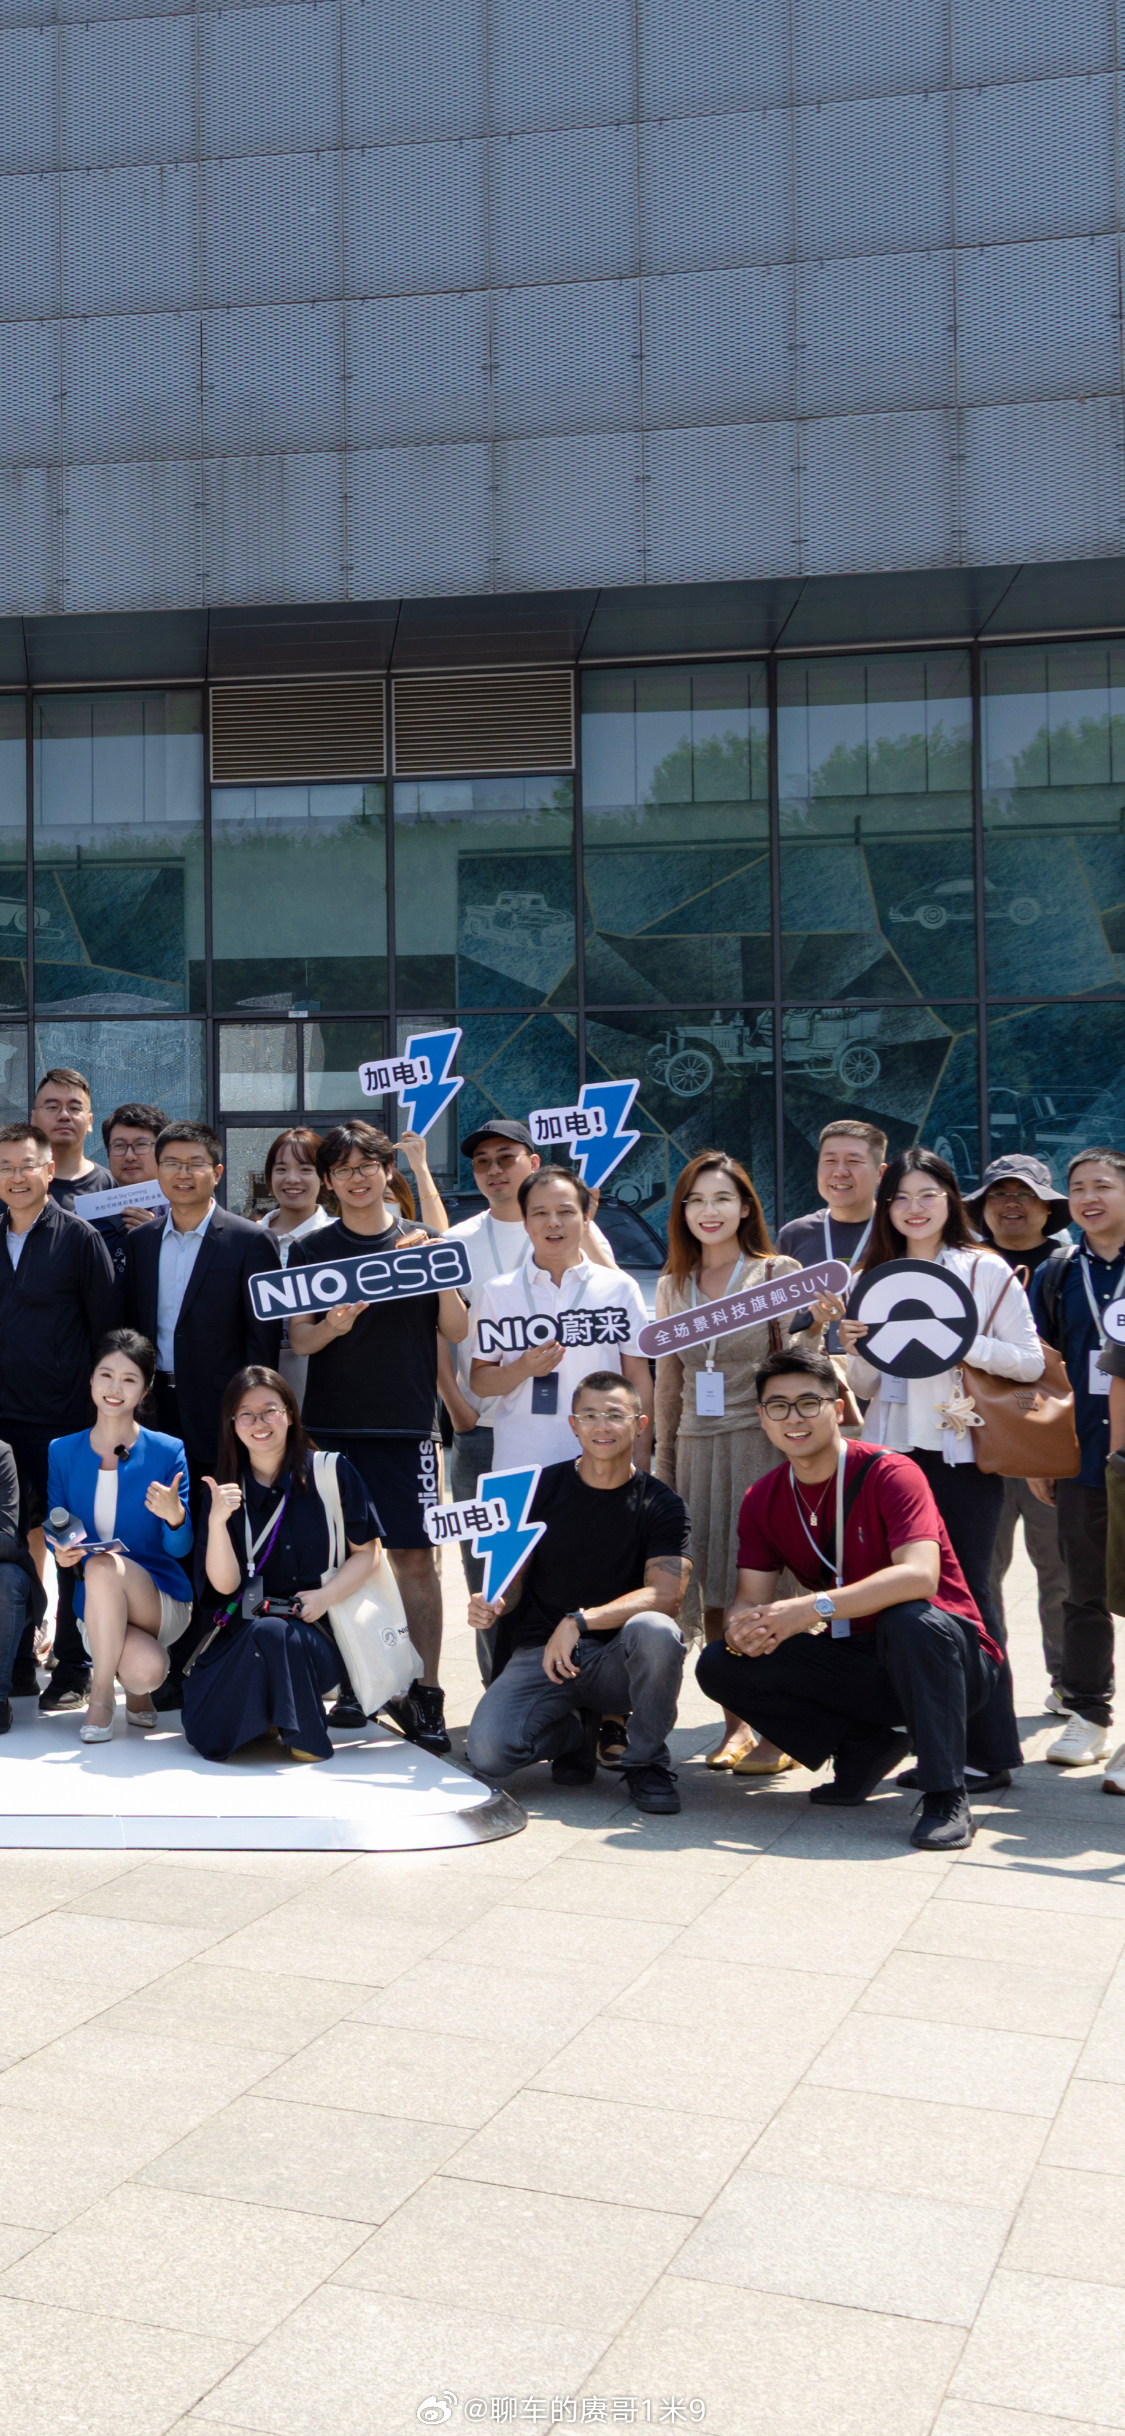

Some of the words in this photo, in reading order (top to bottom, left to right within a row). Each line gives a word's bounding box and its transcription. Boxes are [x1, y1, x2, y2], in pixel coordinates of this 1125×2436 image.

[364, 1060, 428, 1091] 加电!
[535, 1111, 602, 1140] 加电!
[256, 1268, 348, 1313] NIO
[654, 1272, 829, 1347] 全场景科技旗舰SUV
[418, 1440, 438, 1533] didas
[431, 1503, 505, 1540] 加电!
